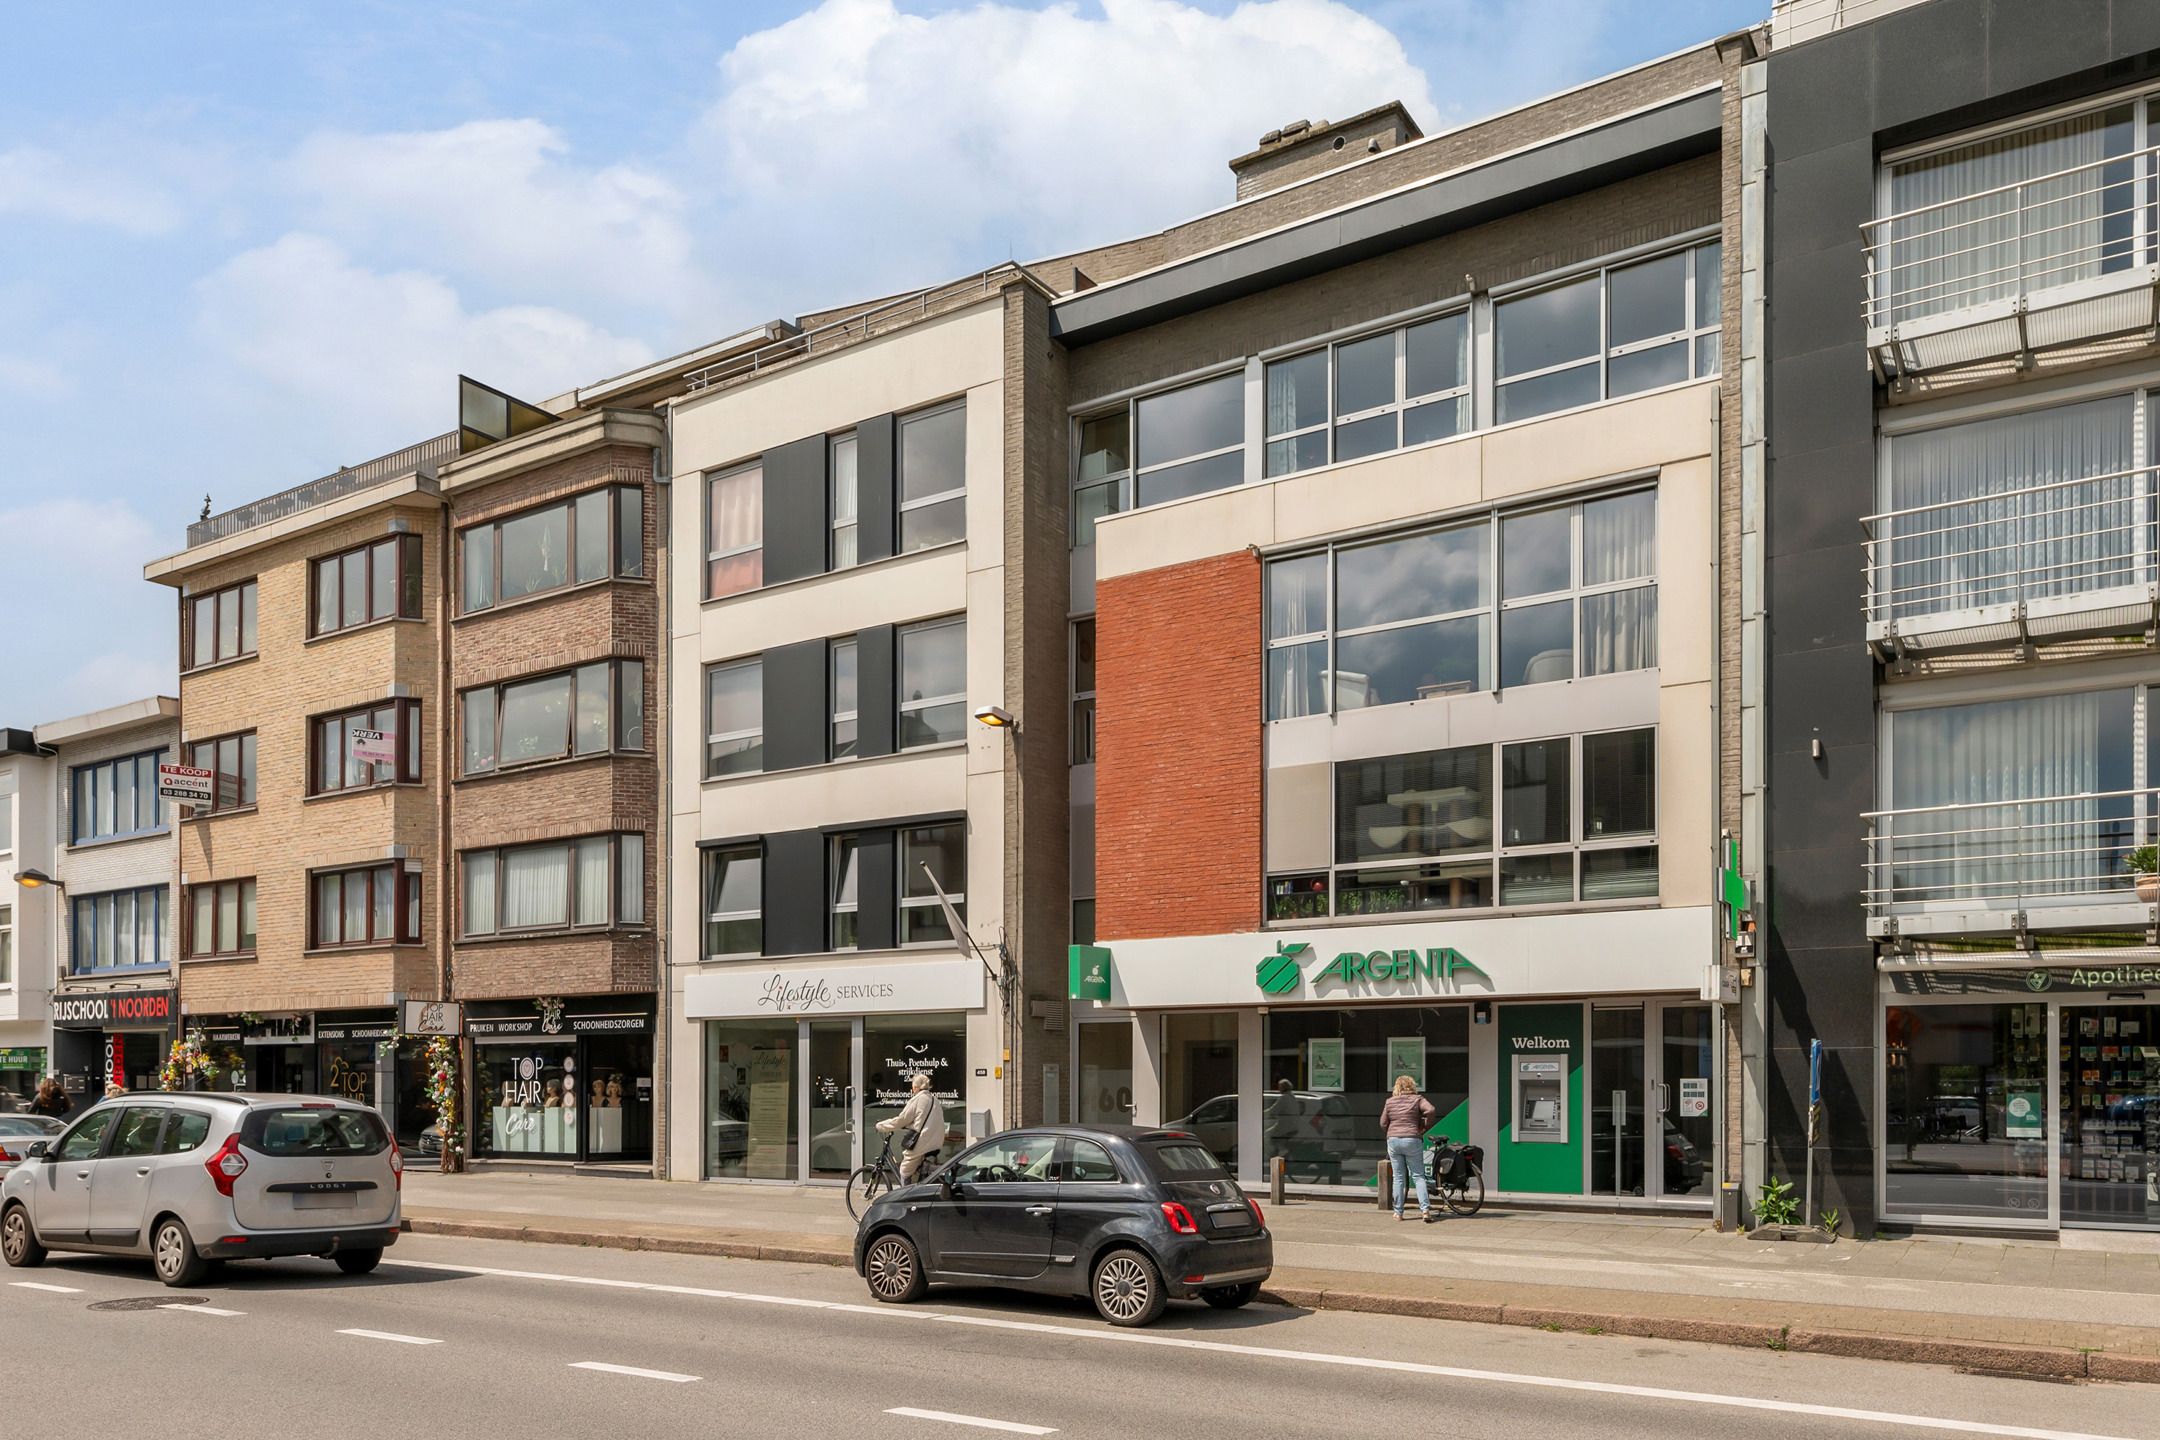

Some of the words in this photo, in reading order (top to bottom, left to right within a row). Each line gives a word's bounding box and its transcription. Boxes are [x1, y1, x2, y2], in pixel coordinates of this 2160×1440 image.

[163, 765, 177, 773] TE
[180, 767, 209, 777] KOOP
[1310, 947, 1490, 983] ARGENTA
[758, 973, 836, 1012] Lifestyle
[836, 983, 894, 999] SERVICES
[54, 1000, 108, 1020] RIJSCHOOL
[119, 997, 169, 1018] NOORDEN
[421, 1012, 444, 1021] HAIR
[469, 1023, 495, 1033] PRUIKEN
[498, 1022, 533, 1032] WORKSHOP
[573, 1018, 645, 1031] SCHOONHEIDSZORGEN
[318, 1030, 345, 1039] EXTENSIONS
[1511, 1035, 1570, 1049] Welkom
[8, 1055, 28, 1064] HUUR
[908, 1057, 940, 1069] Poetshulp
[940, 1057, 949, 1067] &
[511, 1057, 544, 1081] TOP
[341, 1071, 368, 1092] TOP
[505, 1081, 542, 1104] HAIR
[505, 1113, 536, 1135] Care
